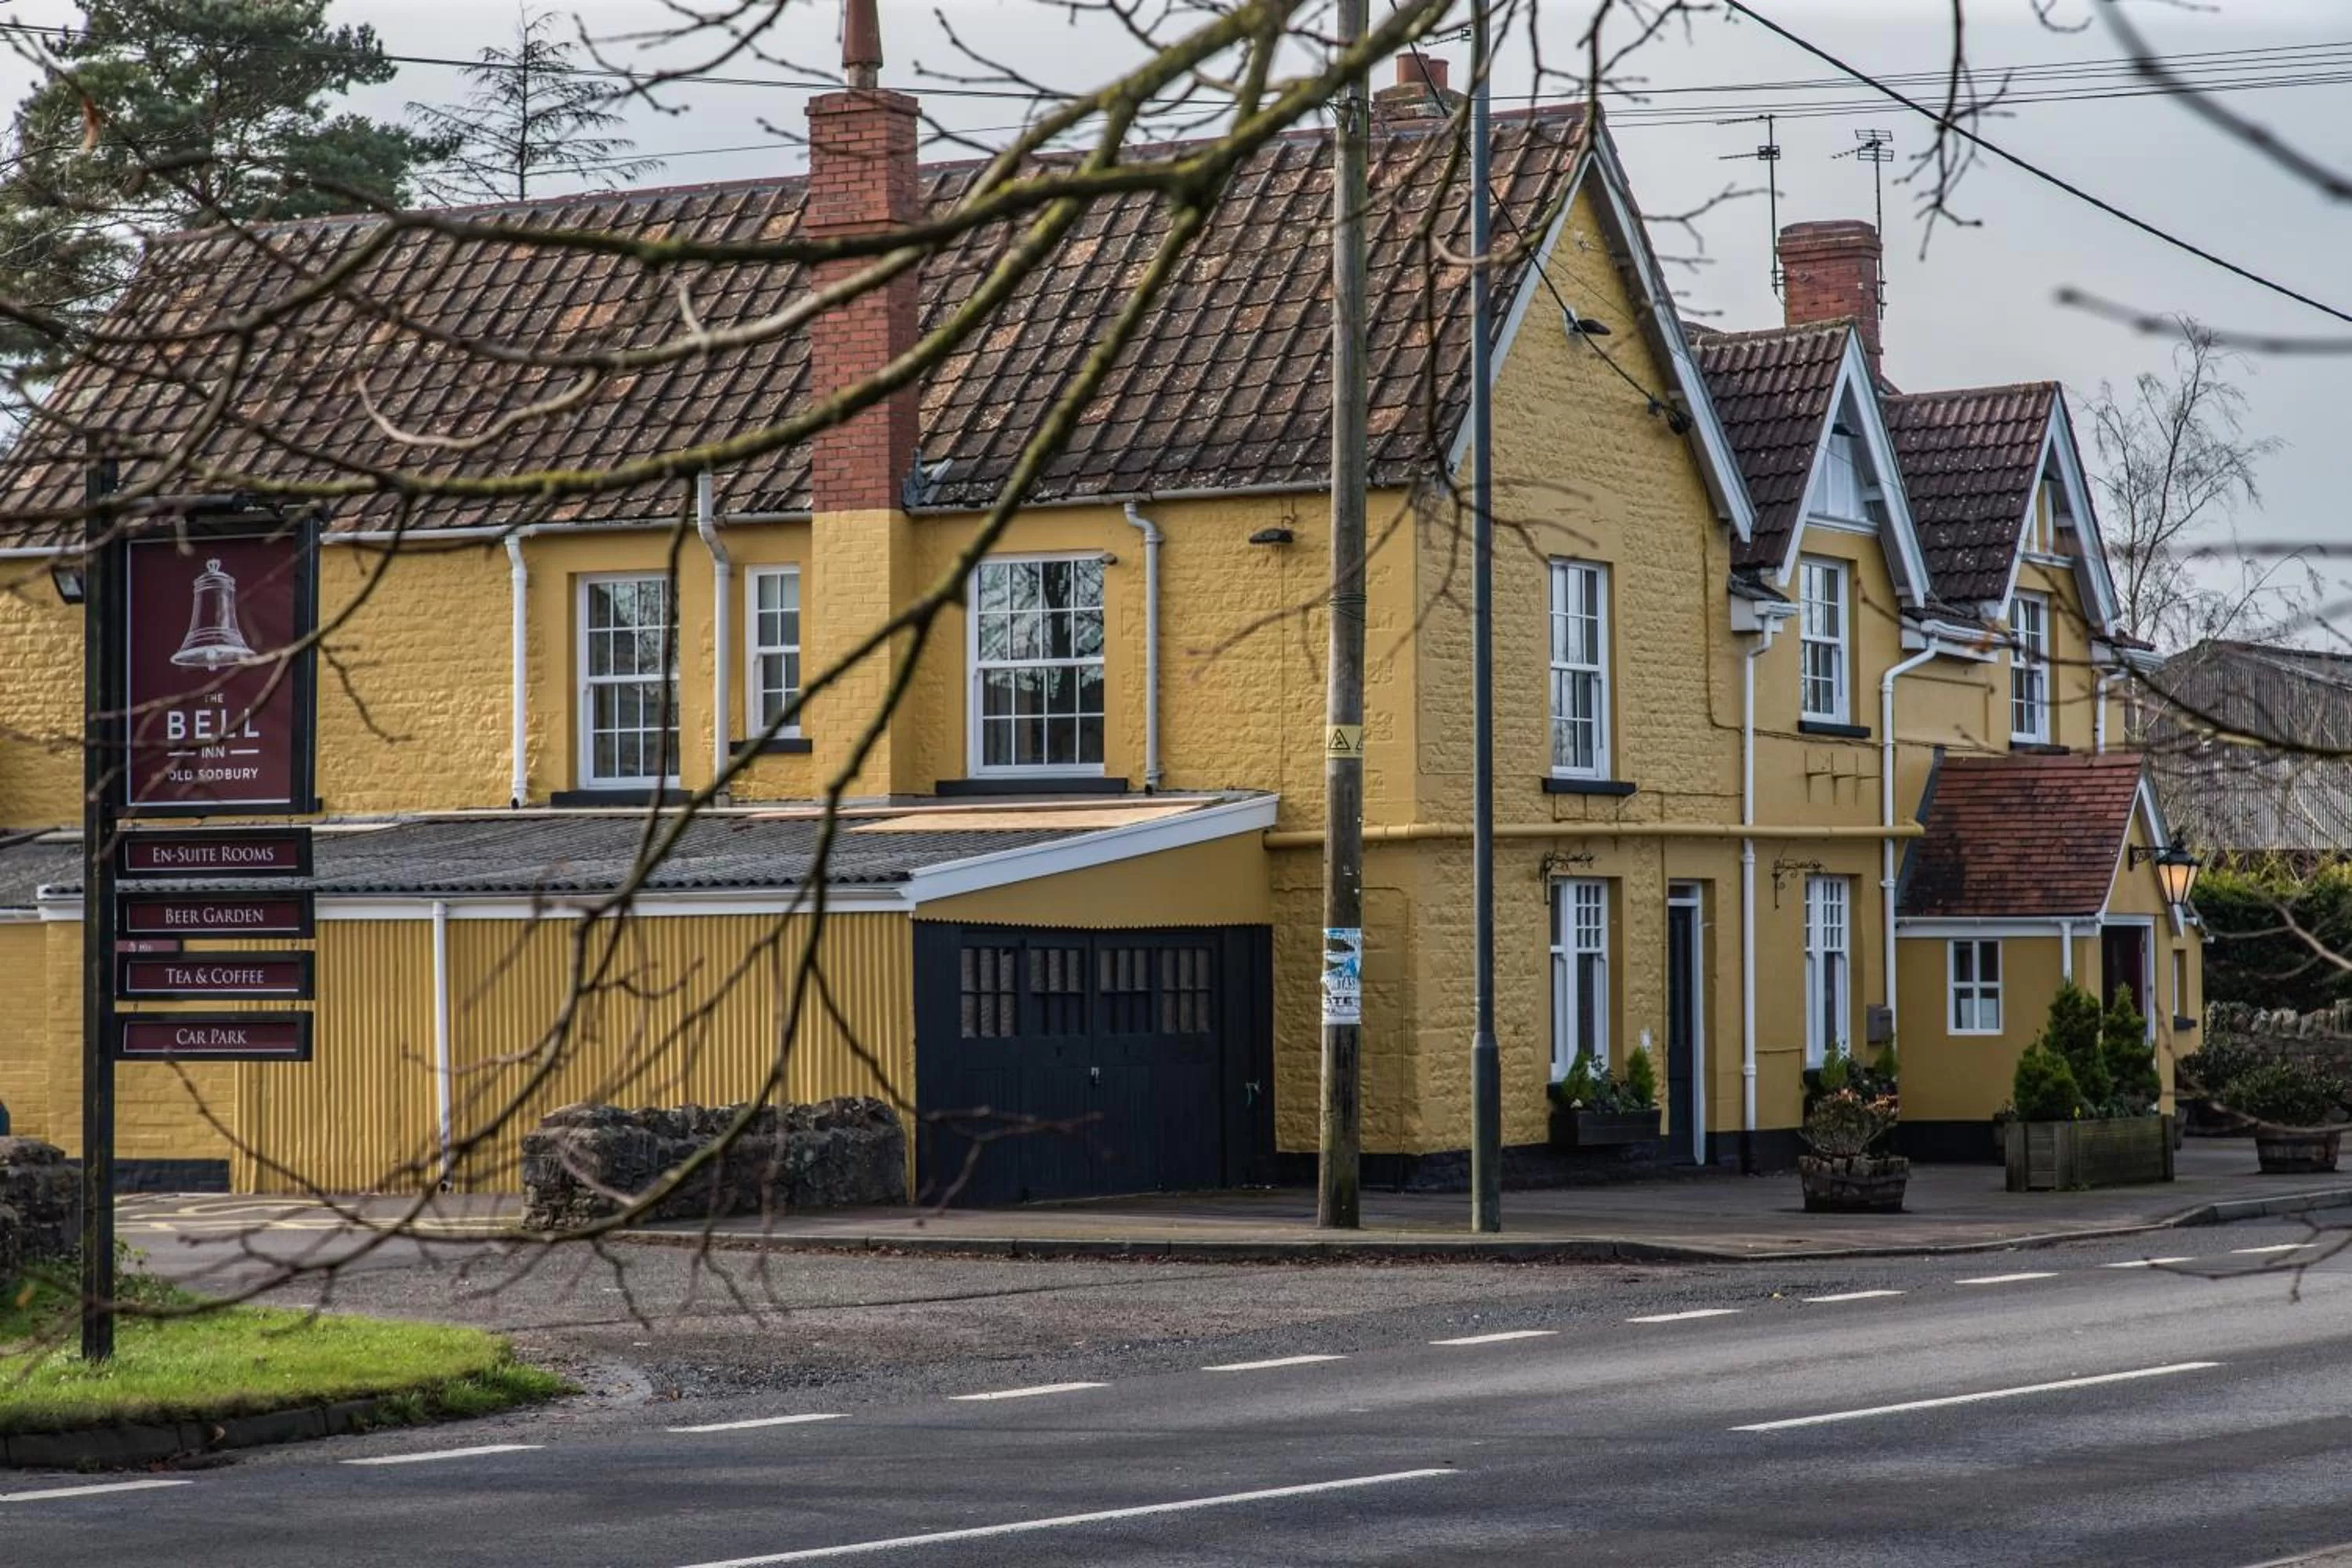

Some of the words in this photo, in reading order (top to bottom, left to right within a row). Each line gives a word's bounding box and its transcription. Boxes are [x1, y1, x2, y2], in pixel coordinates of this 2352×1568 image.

[204, 693, 224, 703] THE
[167, 708, 260, 739] BELL
[201, 746, 226, 758] INN
[169, 770, 193, 781] OLD
[198, 768, 259, 780] SODBURY
[153, 847, 216, 862] EN-SUITE
[222, 847, 274, 862] ROOMS
[165, 908, 199, 924] BEER
[203, 907, 264, 923] GARDEN
[165, 968, 192, 984] TEA
[195, 968, 208, 984] &
[211, 967, 264, 984] COFFEE
[176, 1029, 206, 1045] CAR
[211, 1029, 247, 1044] PARK
